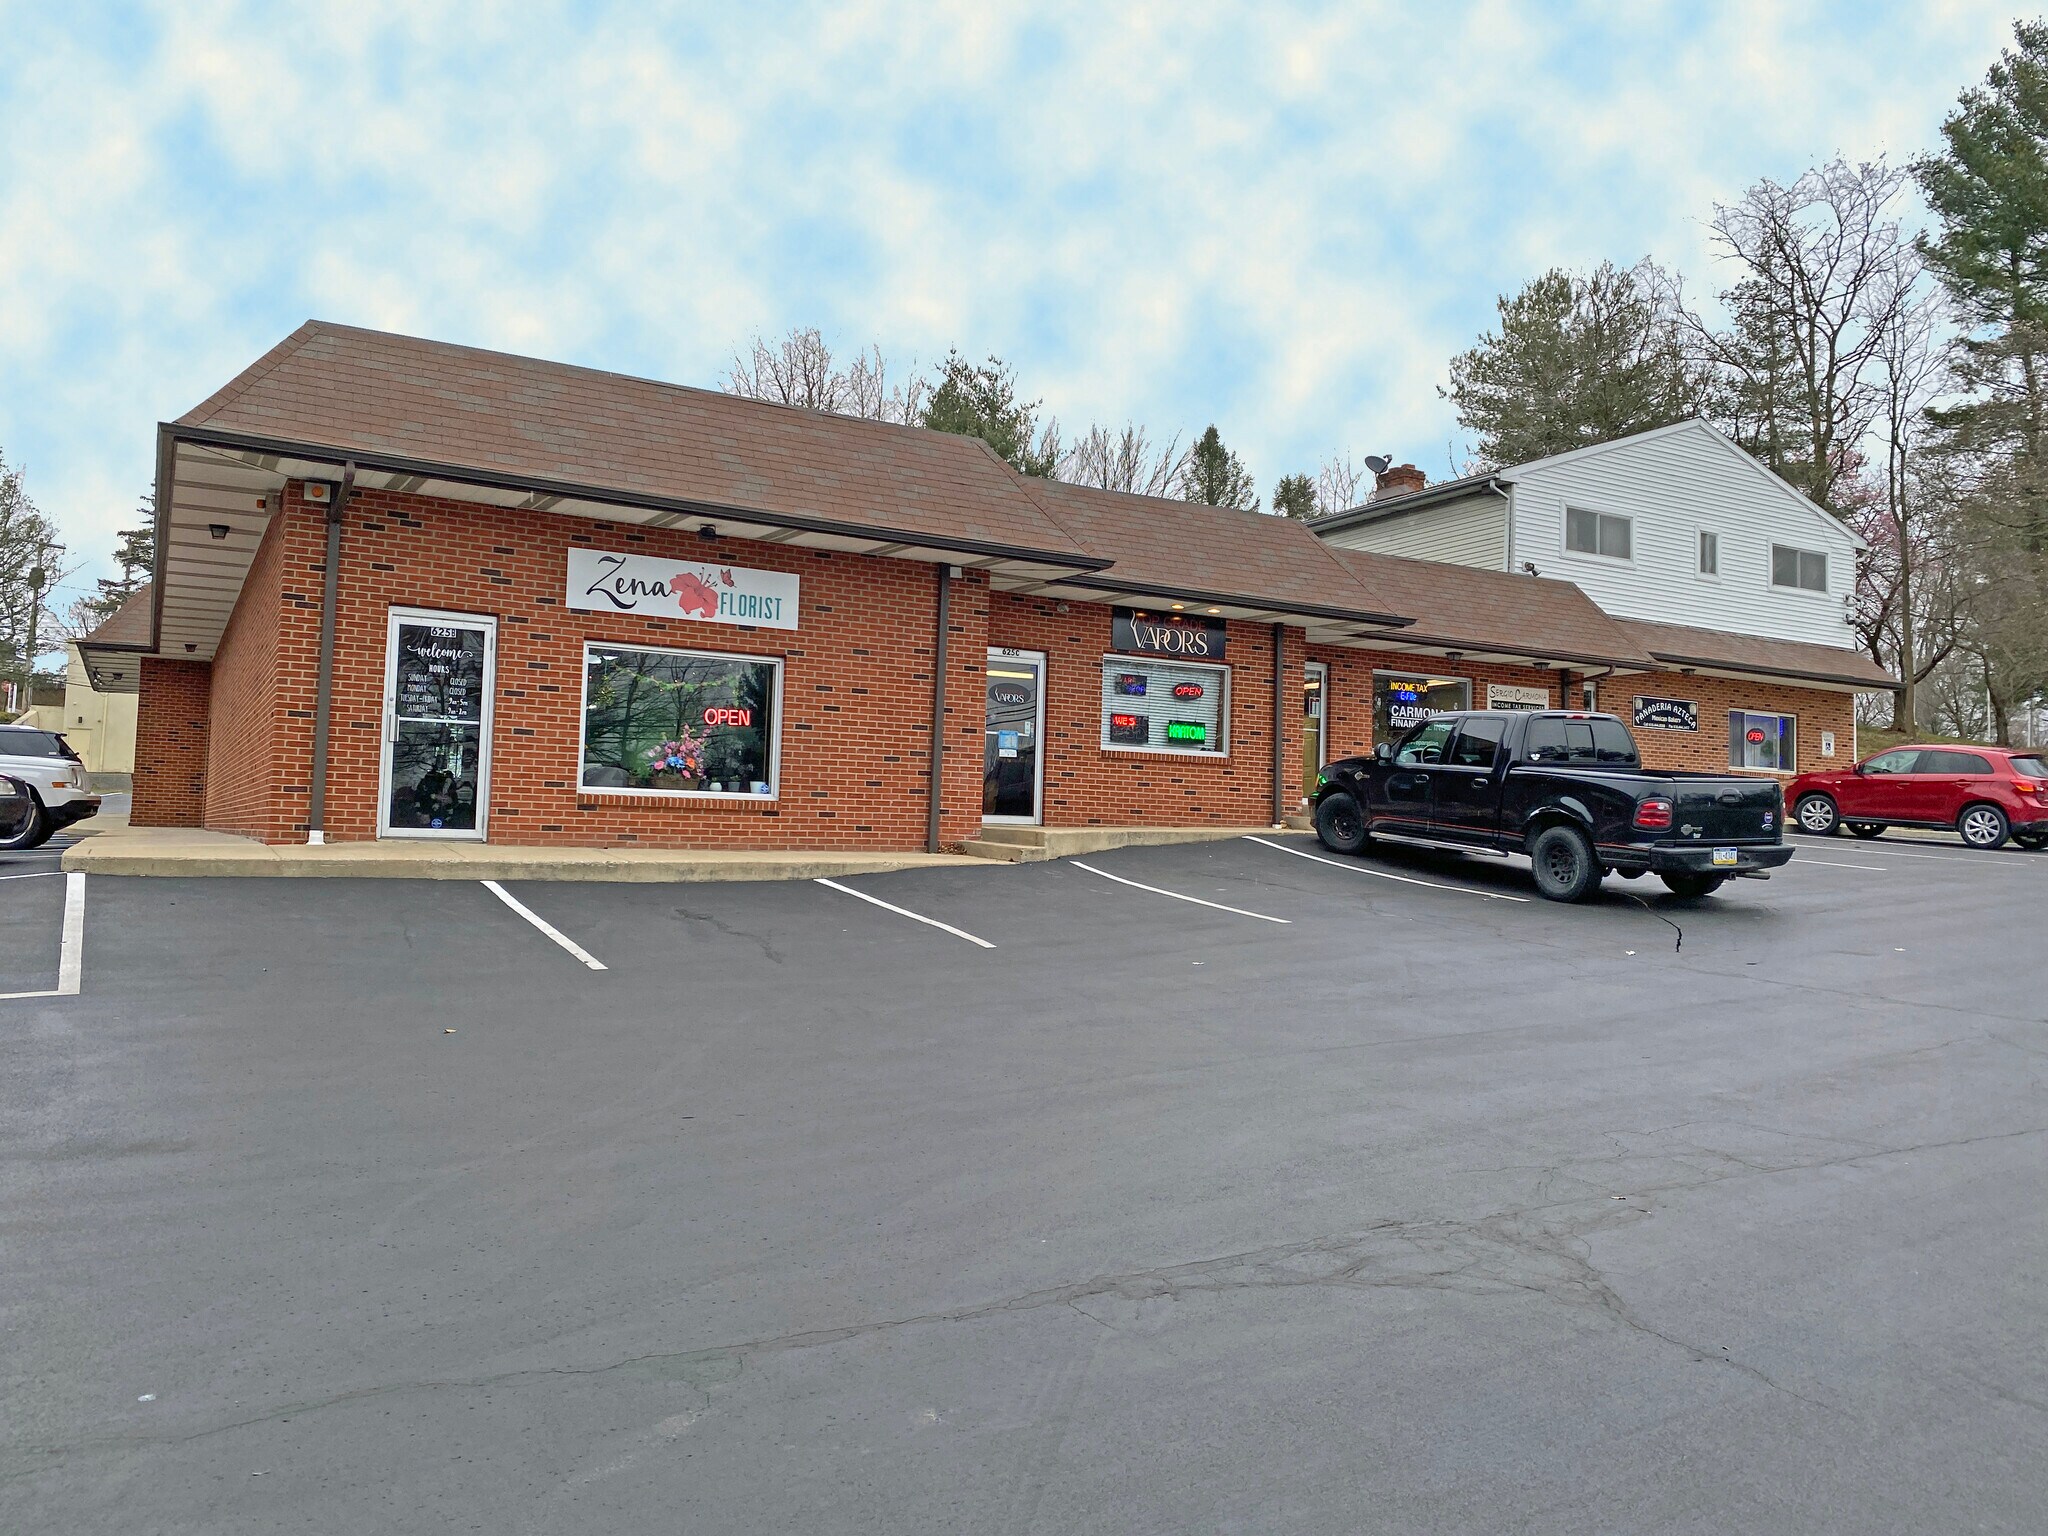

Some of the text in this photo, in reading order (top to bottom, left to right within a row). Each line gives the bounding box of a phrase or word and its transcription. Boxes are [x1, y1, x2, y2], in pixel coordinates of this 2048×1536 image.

[586, 556, 782, 621] Zena FLORIST
[406, 642, 473, 660] welcome
[1002, 648, 1020, 657] 625C
[429, 664, 450, 674] HOURS
[407, 673, 467, 686] SUNDAY CLOSED
[407, 684, 467, 696] MONDAY CLOSED
[1174, 686, 1201, 696] OPEN
[1390, 682, 1428, 692] INCOME TAX
[1489, 685, 1547, 701] SERGIO CARMONA
[704, 707, 751, 726] OPEN
[1391, 706, 1444, 718] CARMON
[1635, 702, 1697, 729] PANADERIA AZTECA
[1747, 732, 1765, 741] OPEN
